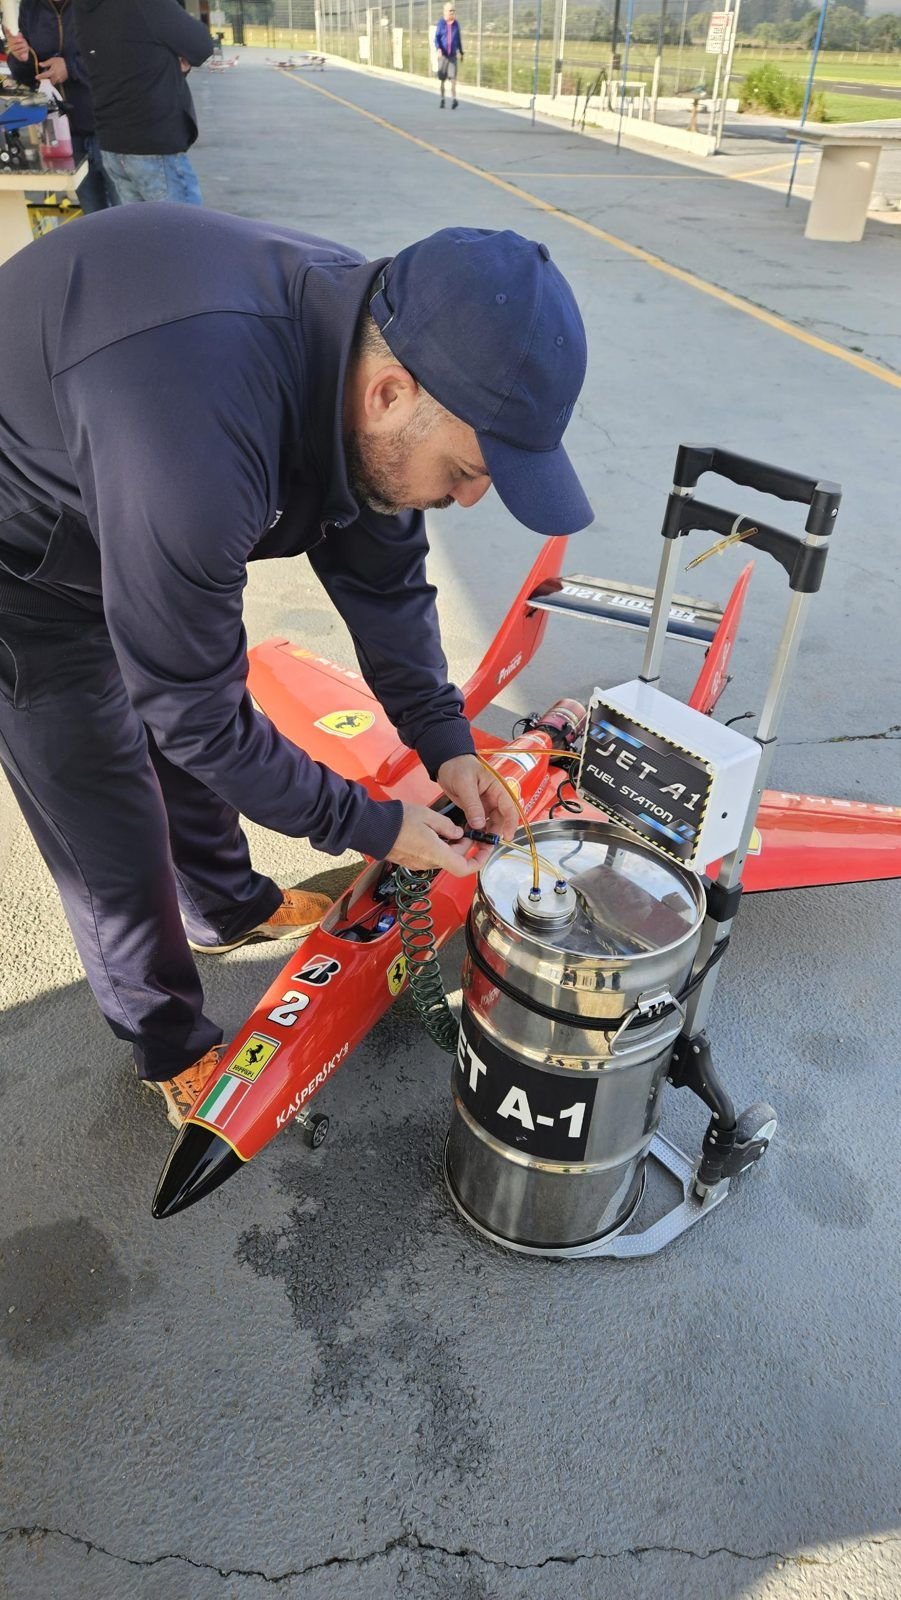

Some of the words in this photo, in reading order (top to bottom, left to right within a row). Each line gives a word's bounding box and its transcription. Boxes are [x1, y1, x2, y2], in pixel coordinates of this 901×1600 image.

[586, 764, 616, 788] FUEL
[619, 785, 674, 823] STATION
[595, 743, 658, 780] JET
[659, 782, 702, 811] A1
[267, 991, 310, 1027] 2
[275, 1049, 345, 1129] KASPERSKY
[457, 1021, 487, 1092] ET
[496, 1085, 586, 1138] A-1
